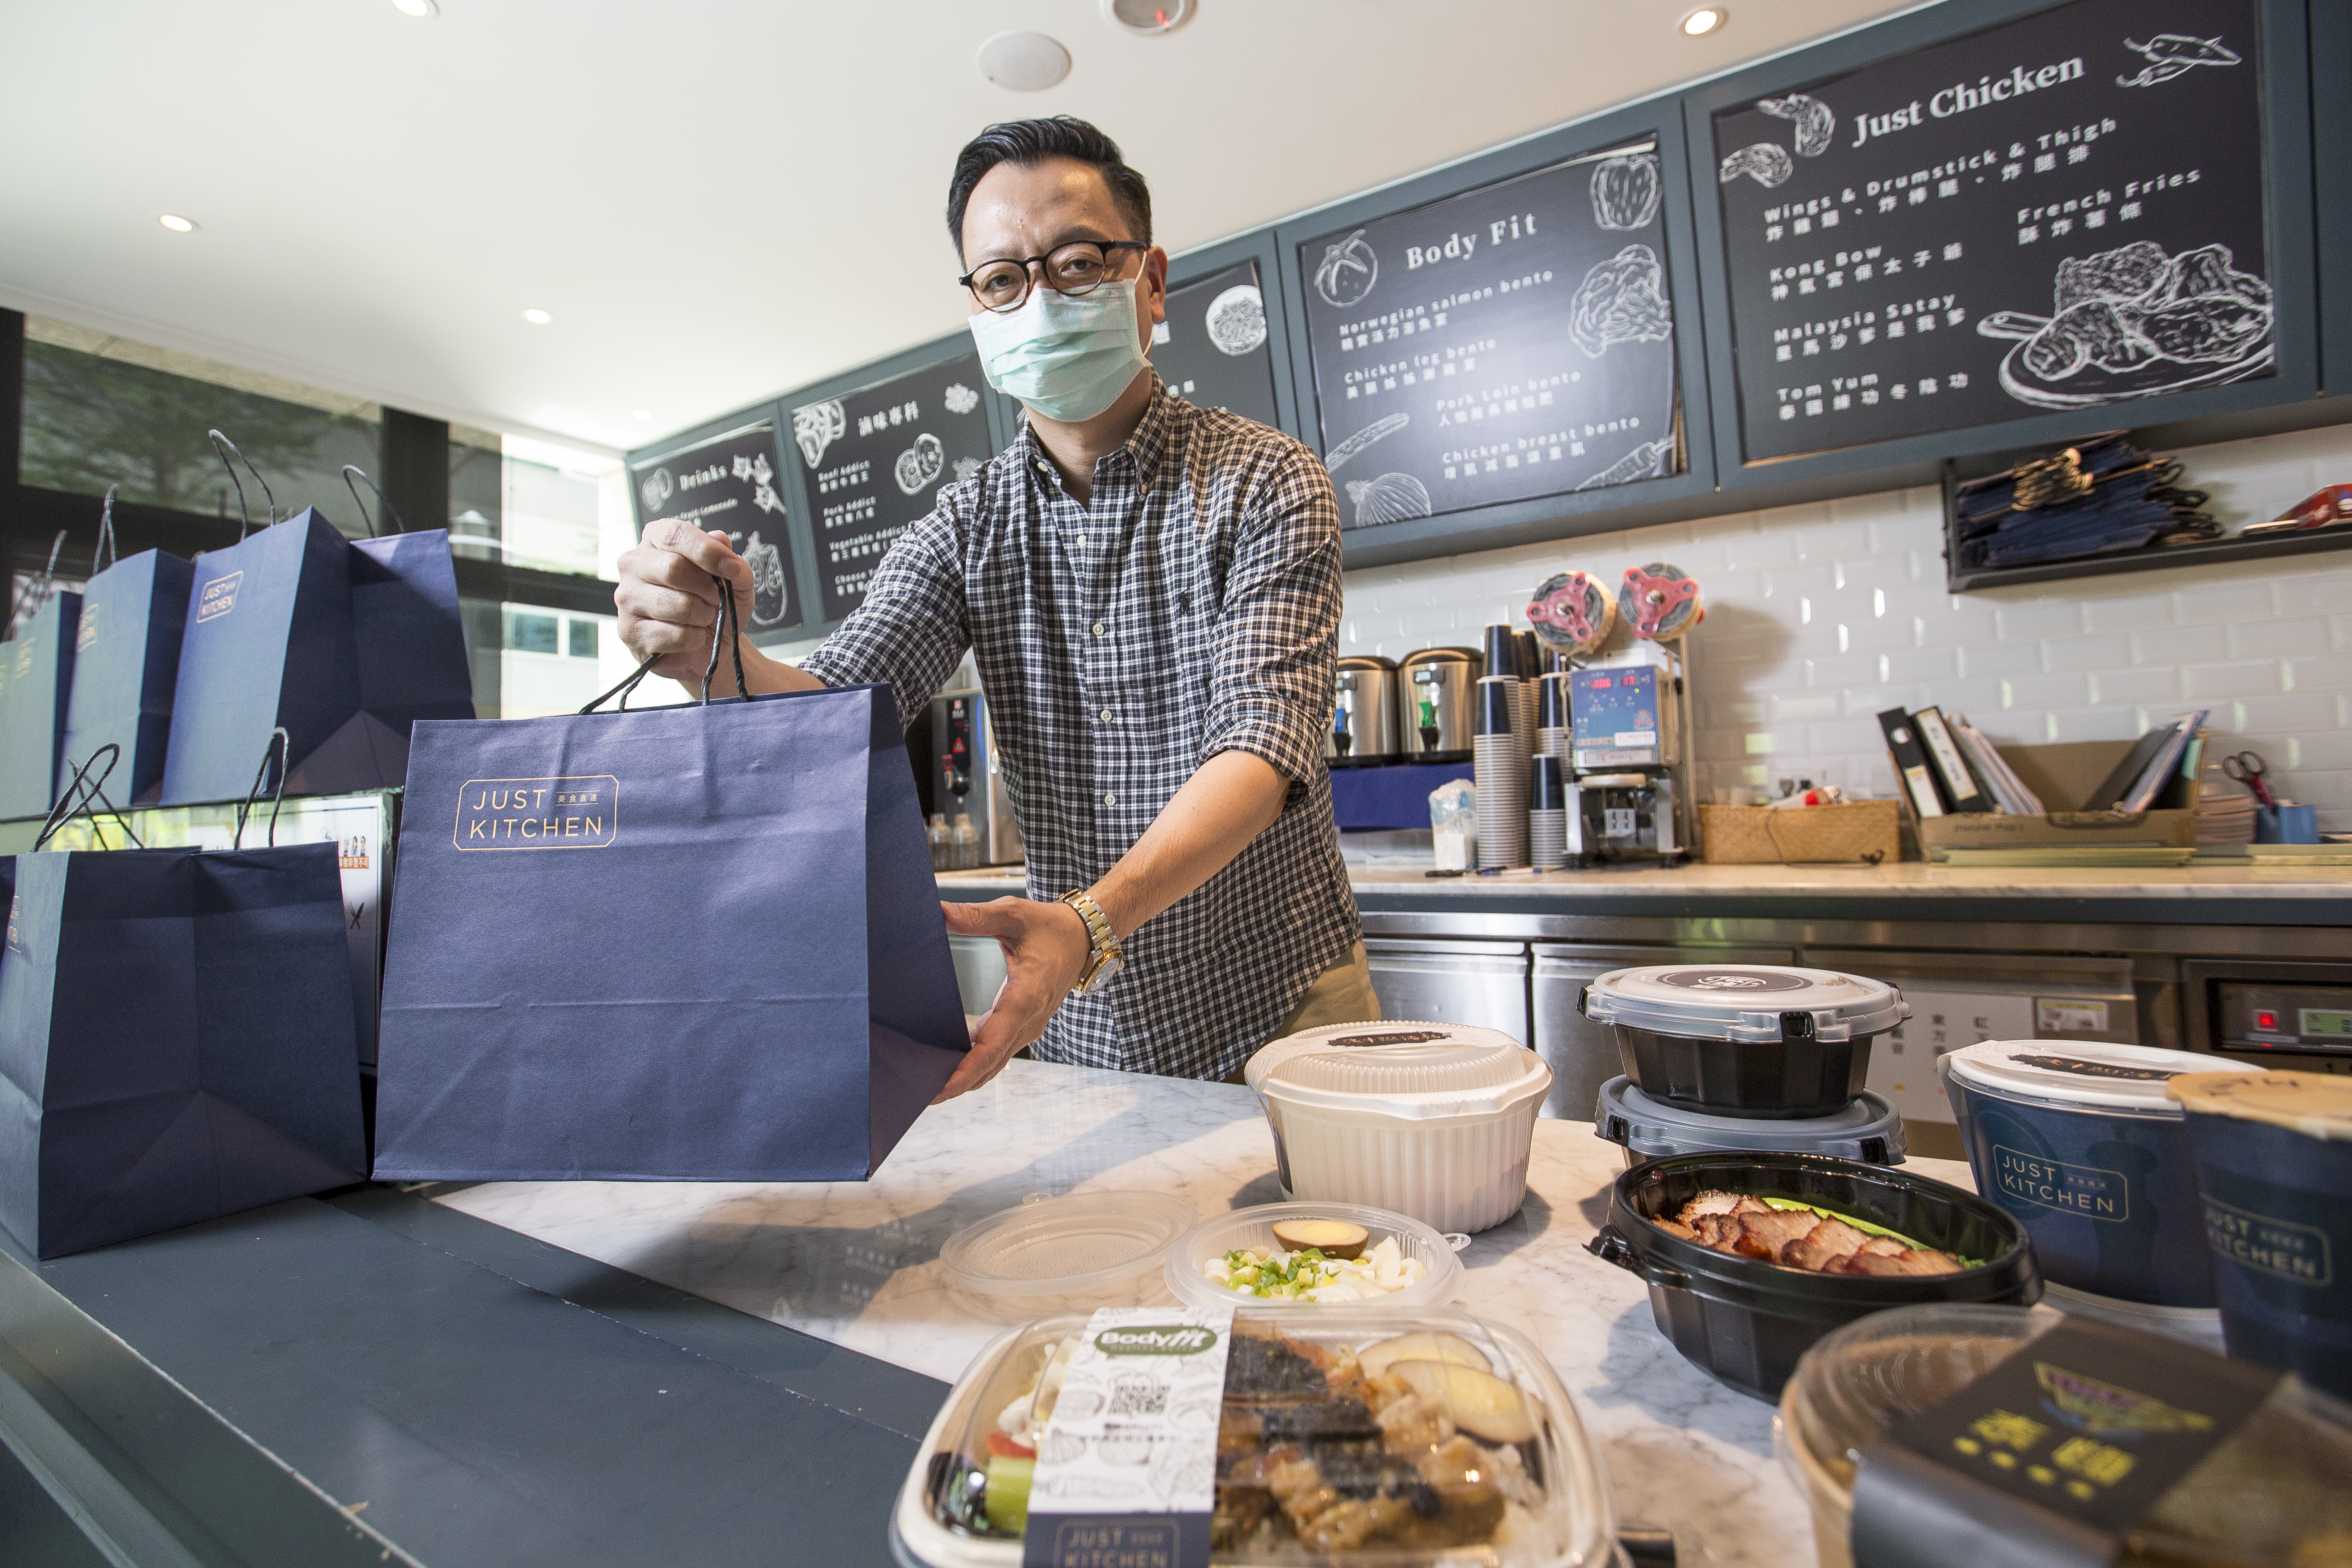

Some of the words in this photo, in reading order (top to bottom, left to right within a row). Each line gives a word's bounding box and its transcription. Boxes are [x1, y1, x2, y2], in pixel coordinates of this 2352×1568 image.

[1852, 100, 1924, 148] Just
[1929, 57, 2086, 118] Chicken
[1764, 196, 1831, 223] Wings
[1841, 188, 1856, 203] &
[1867, 149, 1997, 197] Drumstick
[2009, 142, 2026, 158] &
[2036, 117, 2116, 150] Thigh
[2017, 188, 2112, 224] French
[2125, 169, 2201, 198] Fries
[1406, 233, 1478, 270] Body
[1490, 213, 1537, 246] Fit
[1770, 259, 1825, 282] Kong
[1835, 245, 1882, 267] Bow
[1340, 305, 1424, 336] Norwegian
[1431, 287, 1493, 312] salmon
[1500, 271, 1553, 294] bento
[1774, 311, 1875, 343] Malaysia
[1886, 294, 1956, 319] Satay
[1344, 361, 1407, 385] Chicken
[1414, 353, 1440, 367] leg
[1446, 339, 1496, 360] bento
[1436, 393, 1474, 411] Pork
[1482, 385, 1519, 402] Loin
[1528, 371, 1580, 391] bento
[1776, 384, 1822, 402] Tom
[1832, 374, 1878, 392] Yum
[1442, 443, 1509, 464] Chicken
[1517, 428, 1576, 450] breast
[1584, 417, 1640, 437] bento
[680, 464, 728, 491] Drinks
[818, 468, 839, 483] Beef
[840, 460, 871, 476] Addict
[823, 504, 844, 517] Pork
[846, 496, 876, 512] Addict
[829, 533, 874, 551] Vegetable
[204, 583, 225, 600] JUST
[473, 789, 546, 810] JUST
[558, 793, 598, 803] 美食直達
[470, 817, 601, 839] KITCHEN
[2003, 1156, 2055, 1181] JUST
[2005, 1173, 2113, 1213] KITCHEN
[1101, 1328, 1209, 1348] Bodyfit
